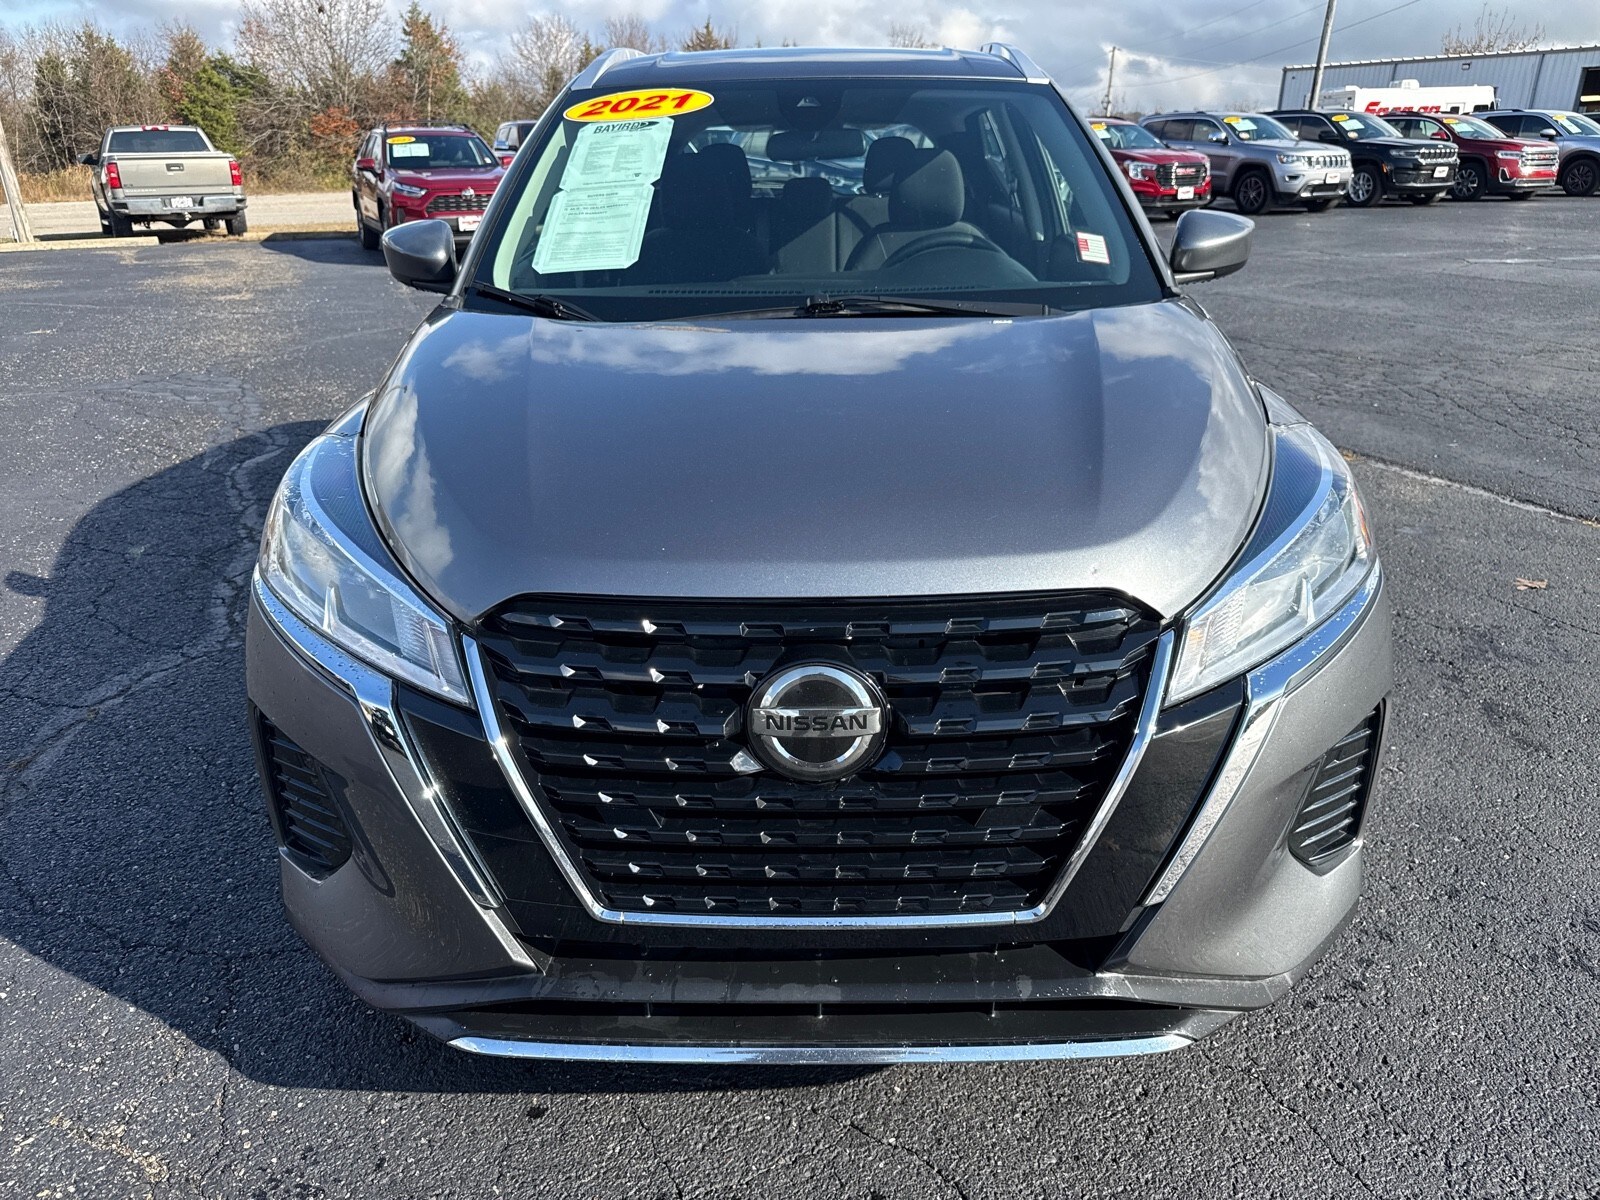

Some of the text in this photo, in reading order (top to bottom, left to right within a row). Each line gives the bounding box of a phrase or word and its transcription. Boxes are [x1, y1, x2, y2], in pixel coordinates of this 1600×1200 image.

[577, 93, 694, 118] 2021
[593, 121, 641, 135] BAYIRD
[766, 714, 867, 731] NISSAN
